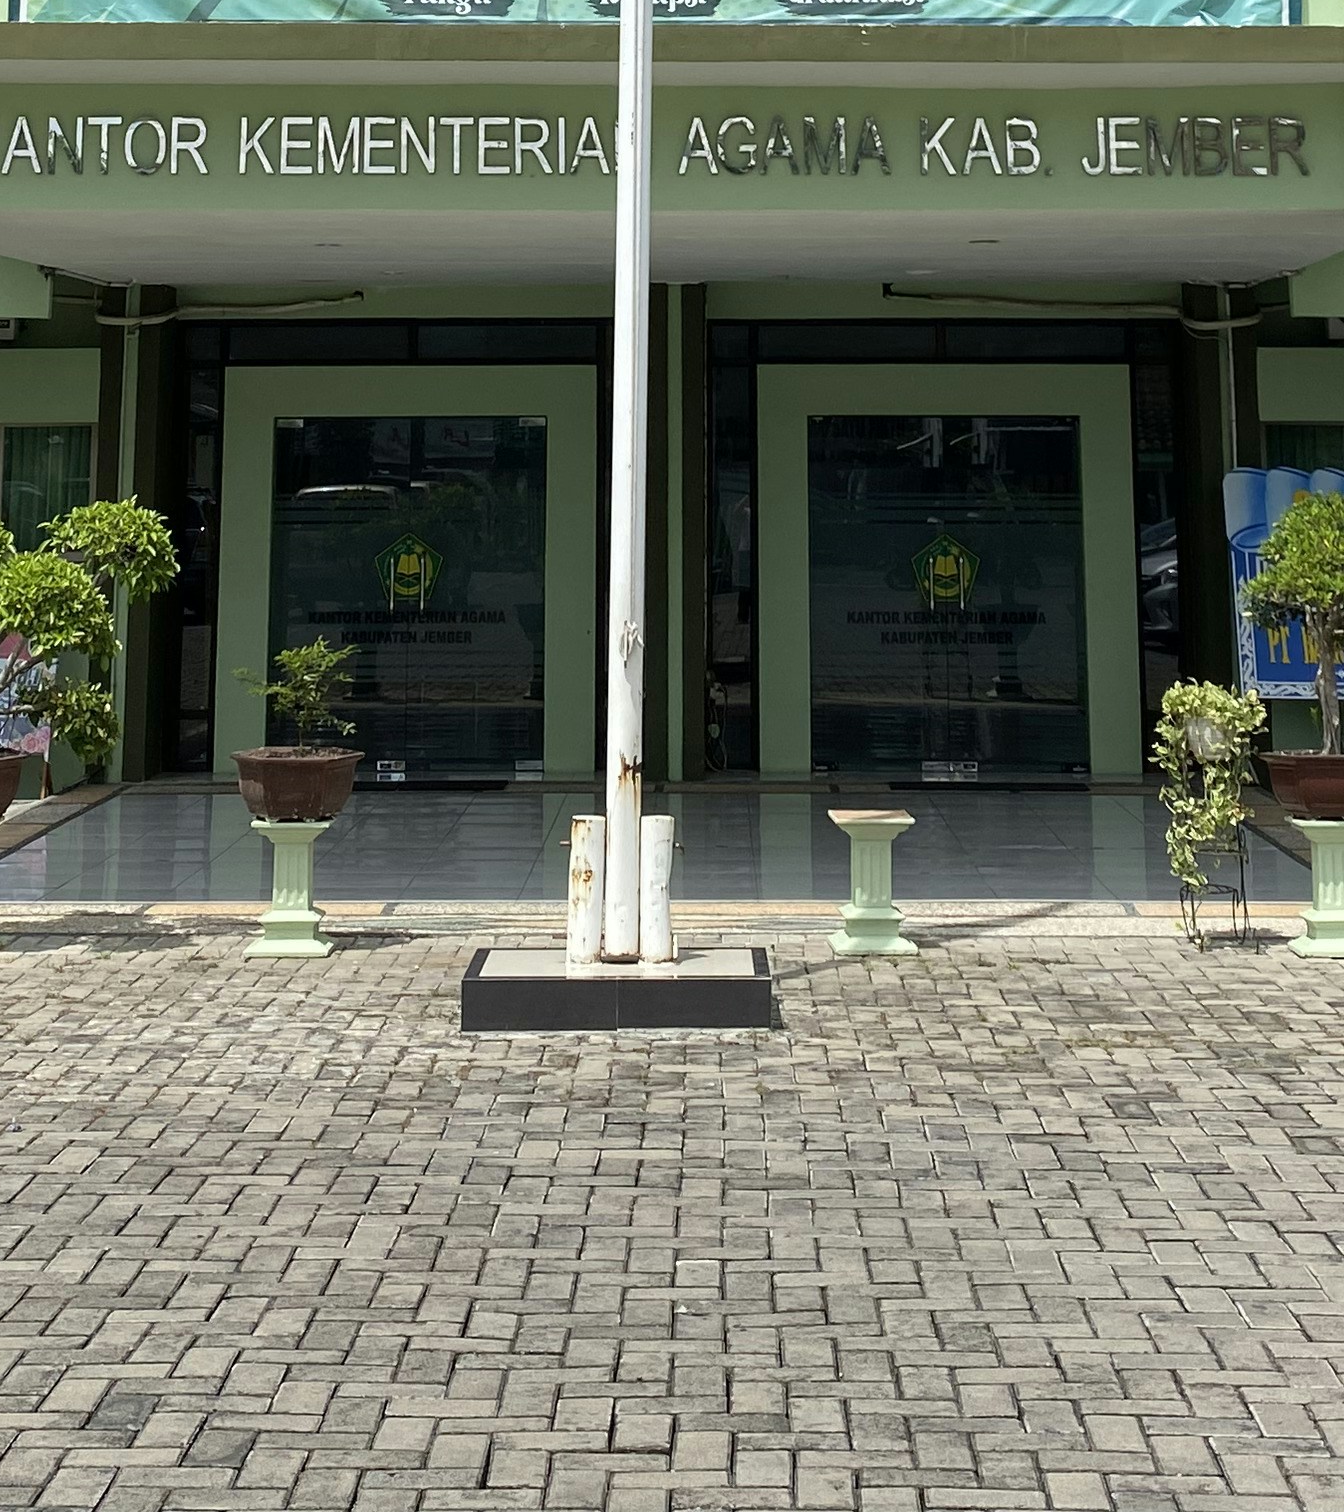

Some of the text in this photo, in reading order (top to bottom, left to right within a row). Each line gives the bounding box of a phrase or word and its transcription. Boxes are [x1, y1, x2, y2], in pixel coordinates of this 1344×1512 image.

[238, 115, 619, 175] KEMENTERIA
[678, 115, 893, 175] AGAMA
[918, 115, 1054, 175] KAB.
[1080, 115, 1311, 176] JEMBER
[307, 610, 506, 625] KANTOR KEMENTERIAN AGAMA
[846, 610, 1047, 625] KANTOR KEMENTERIAN AGAMA
[341, 630, 473, 644] KABUPATEN JEMBER
[880, 631, 1014, 645] KABUPATEN JEMBER
